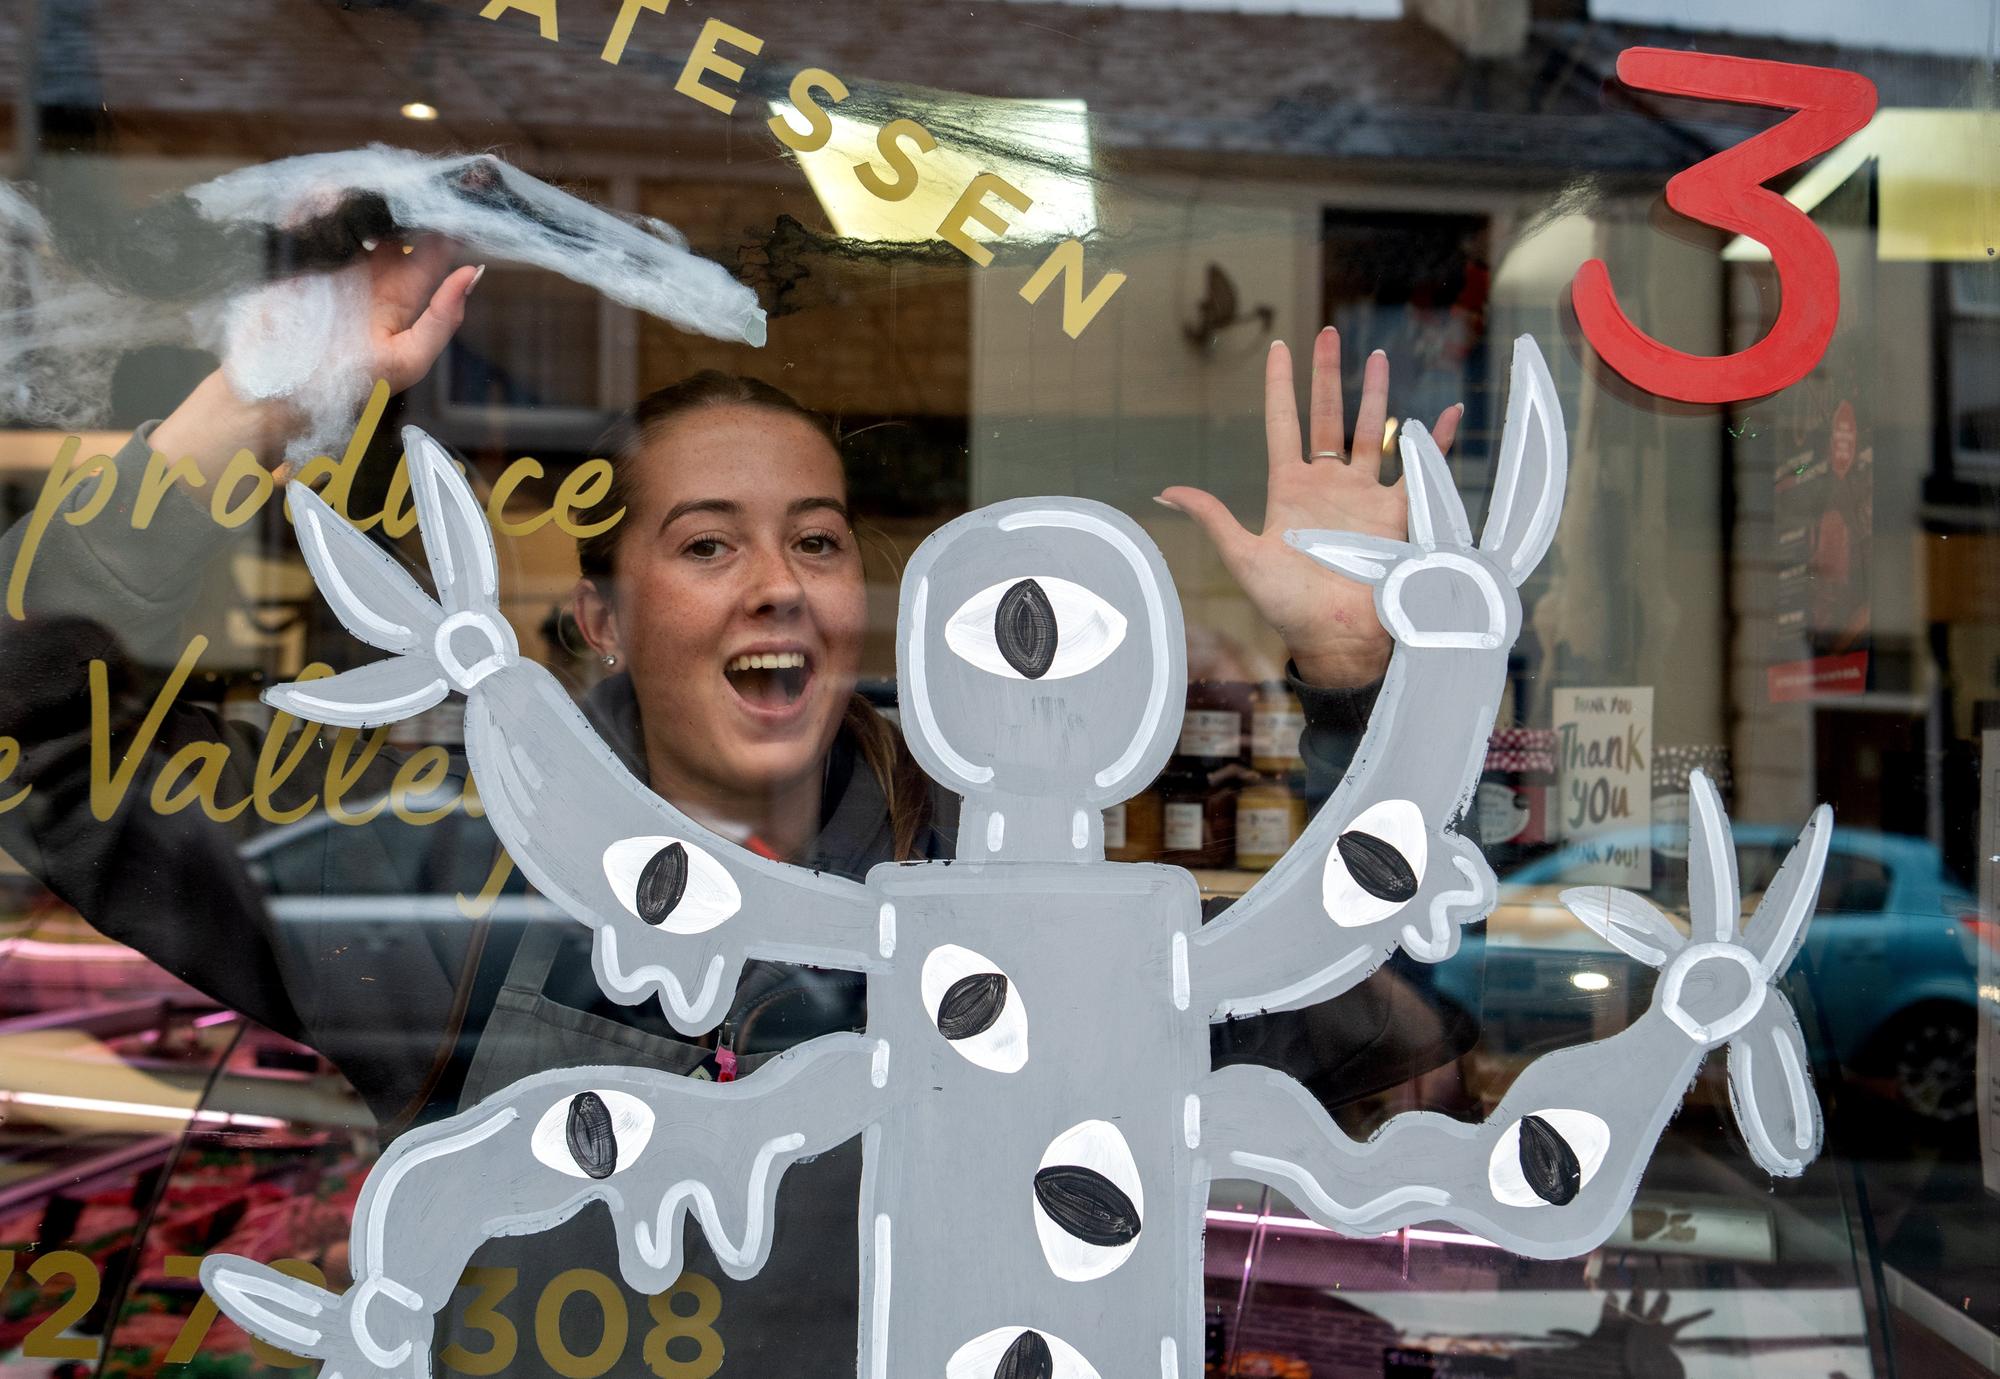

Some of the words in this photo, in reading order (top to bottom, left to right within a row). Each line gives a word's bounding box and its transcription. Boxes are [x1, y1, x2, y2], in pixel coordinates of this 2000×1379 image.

[1572, 46, 1878, 403] 3
[1557, 722, 1646, 774] Thank
[0, 1250, 100, 1360] 2
